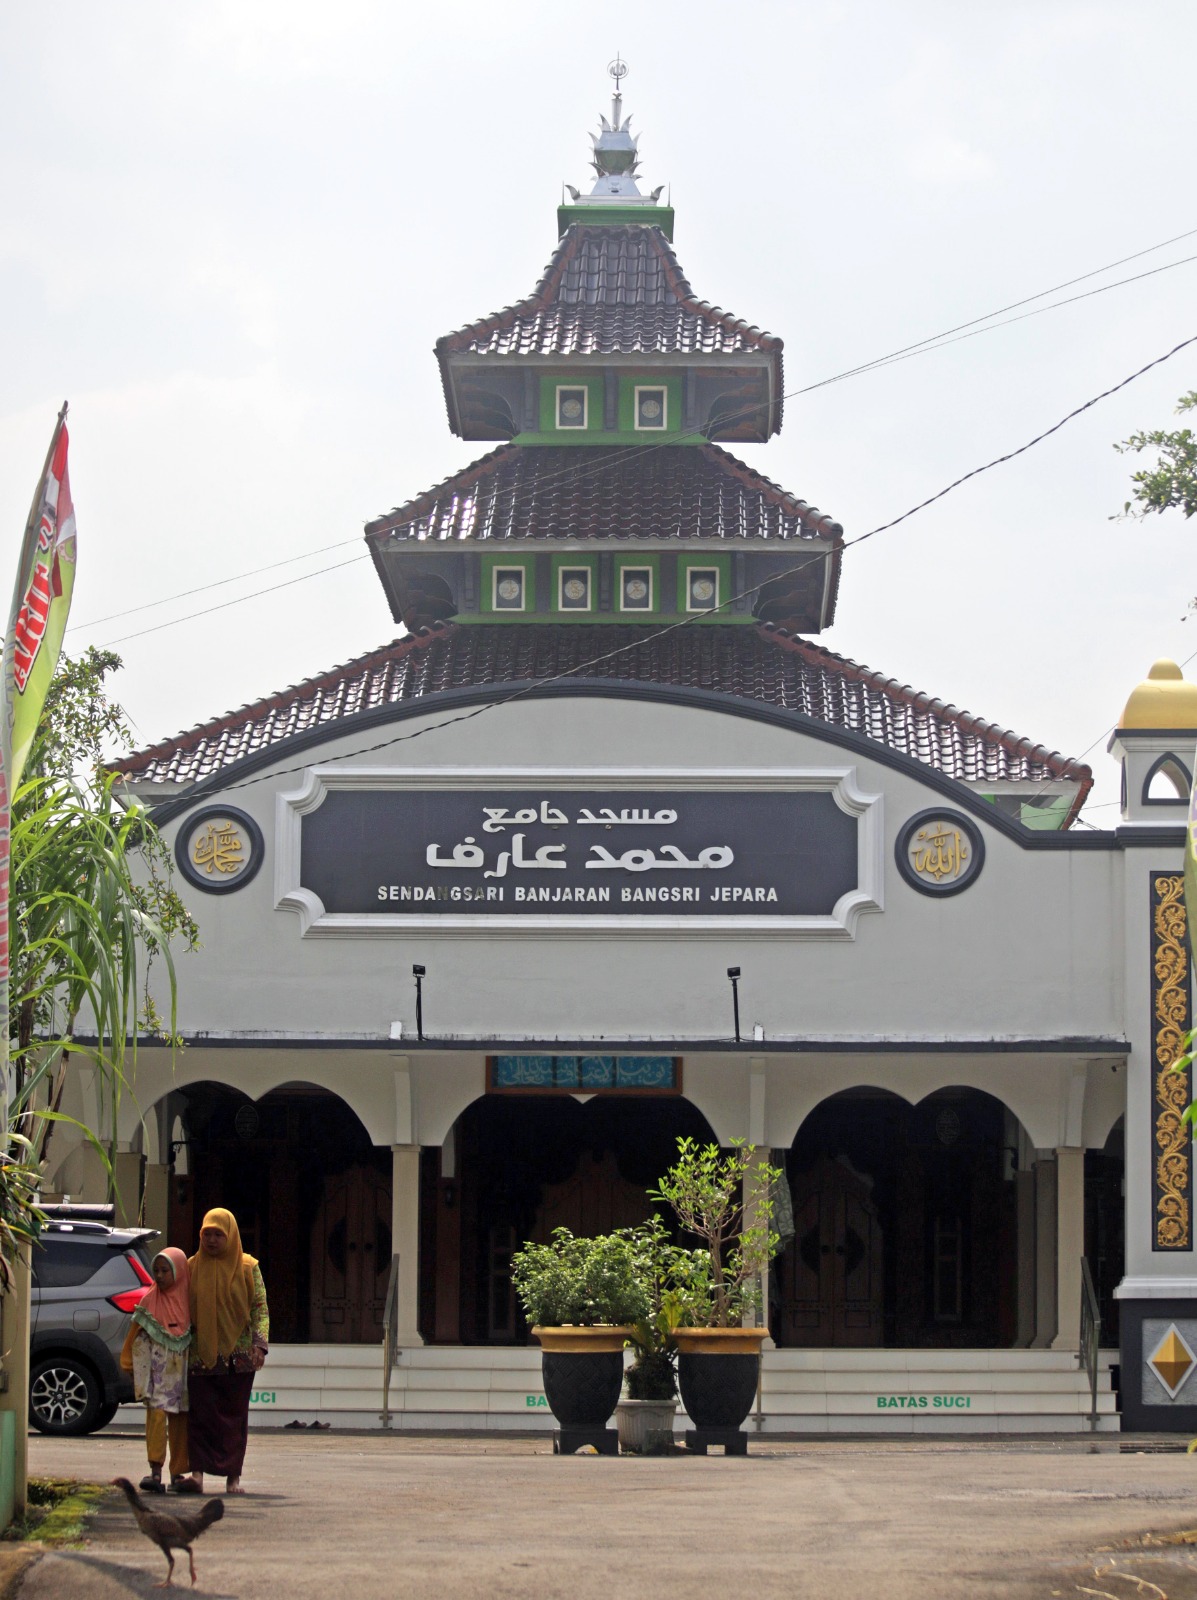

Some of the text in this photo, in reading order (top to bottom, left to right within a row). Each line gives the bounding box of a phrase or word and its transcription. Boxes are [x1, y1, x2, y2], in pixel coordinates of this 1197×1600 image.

[482, 800, 678, 833] مسجد جامع
[426, 833, 734, 879] محمد عارف
[377, 886, 778, 902] SENDANGSARI BANJARAN BANGSRI JEPARA
[249, 1391, 276, 1404] UCI
[877, 1396, 970, 1408] BATAS SUCI
